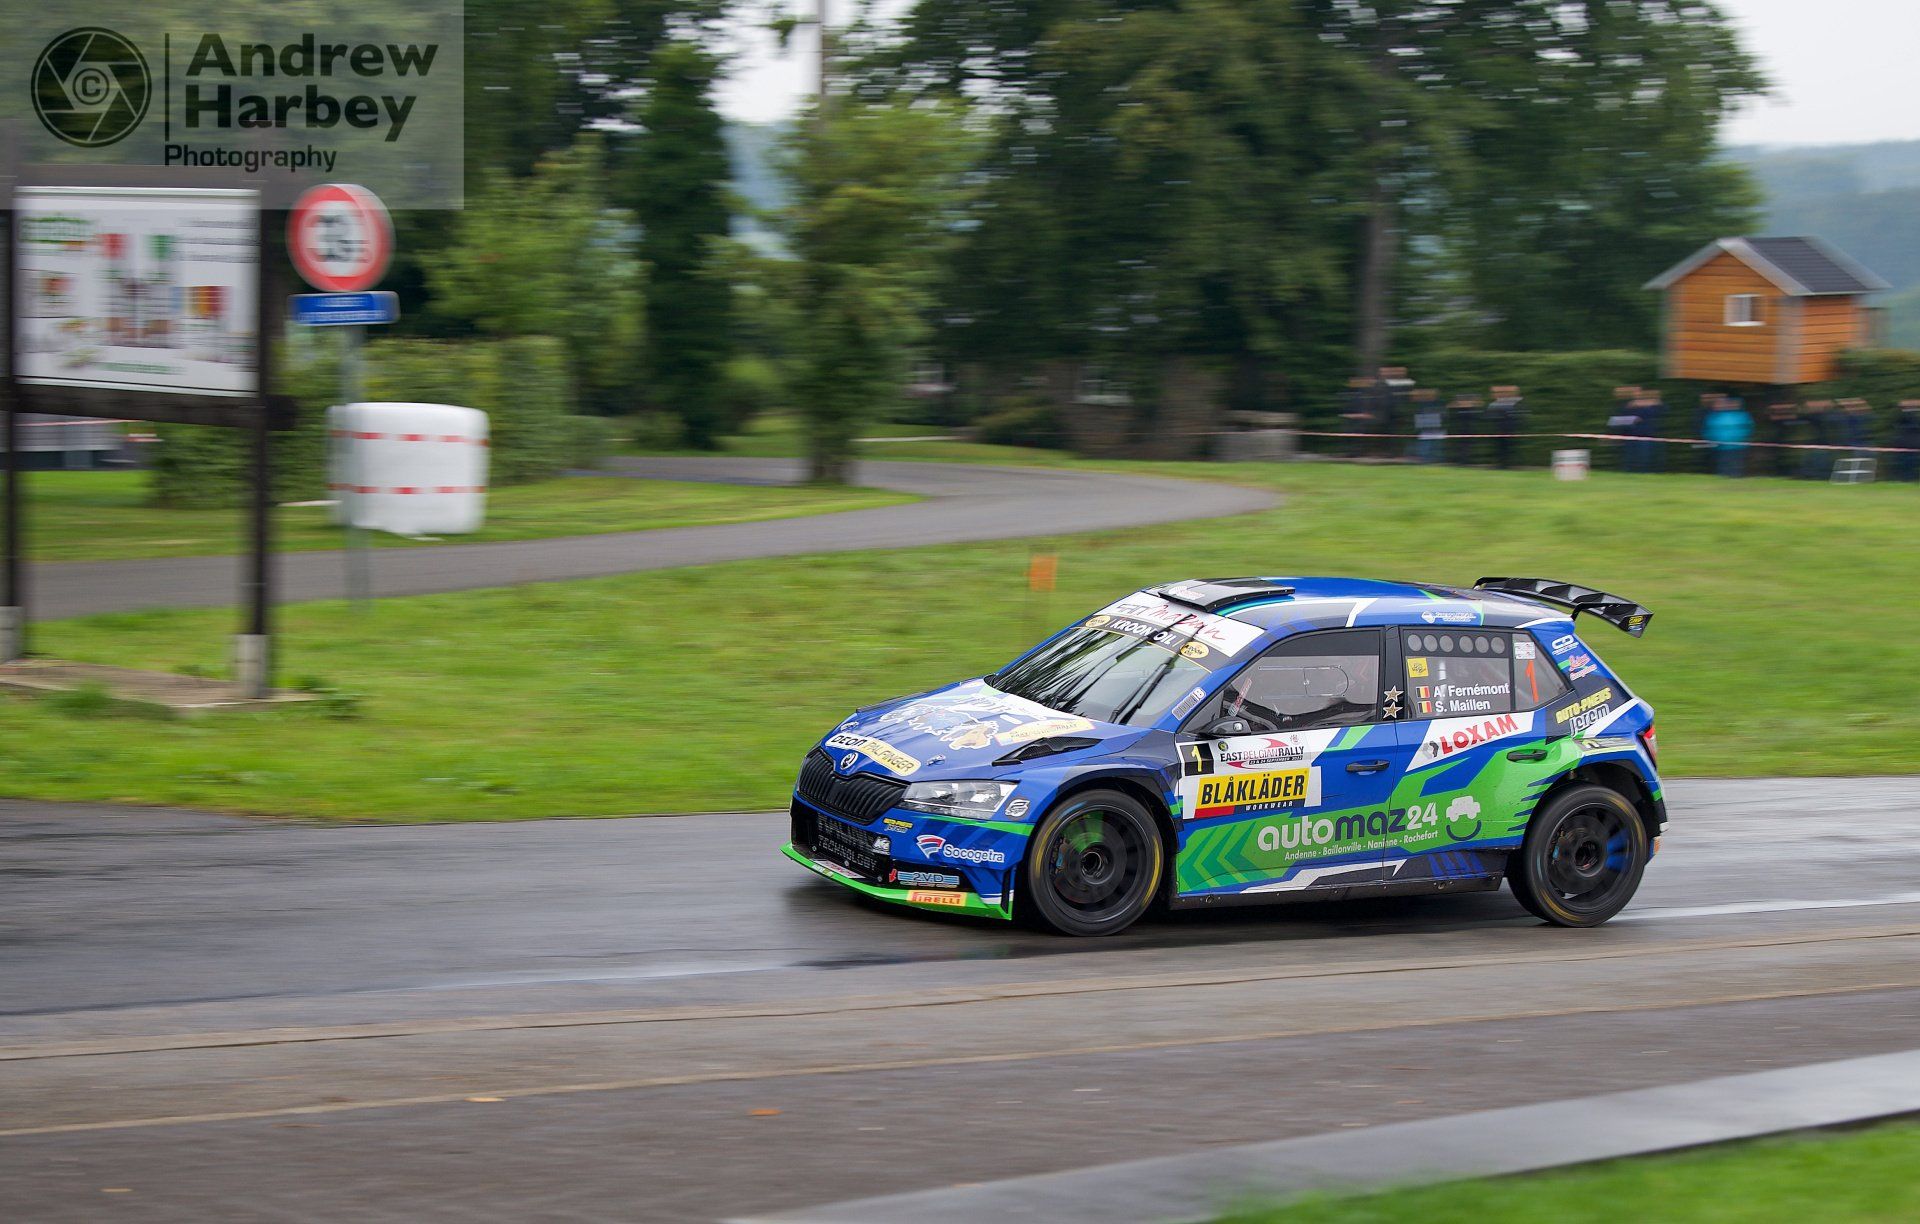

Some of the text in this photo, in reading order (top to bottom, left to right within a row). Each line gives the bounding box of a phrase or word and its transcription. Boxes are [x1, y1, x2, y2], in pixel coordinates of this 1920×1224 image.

[1447, 683, 1511, 697] Fernémont
[1525, 660, 1539, 704] 1
[1435, 700, 1491, 713] S. Maillen
[1440, 713, 1519, 755] LOXAM
[863, 742, 915, 772] PALFINGER
[1191, 745, 1203, 772] 1
[1220, 751, 1242, 762] EAST
[1278, 746, 1304, 757] RALLY
[1201, 774, 1305, 805] BLÅKLÄDER
[1246, 801, 1293, 811] WORKWEAR
[1257, 802, 1438, 852] automaz24
[944, 845, 1004, 864] Socogetra
[1284, 850, 1317, 861] Andenne
[1323, 841, 1362, 856] Baillonville
[1367, 839, 1398, 850] Naninne
[1403, 830, 1438, 844] Rochefort
[912, 891, 961, 905] PIRELLI
